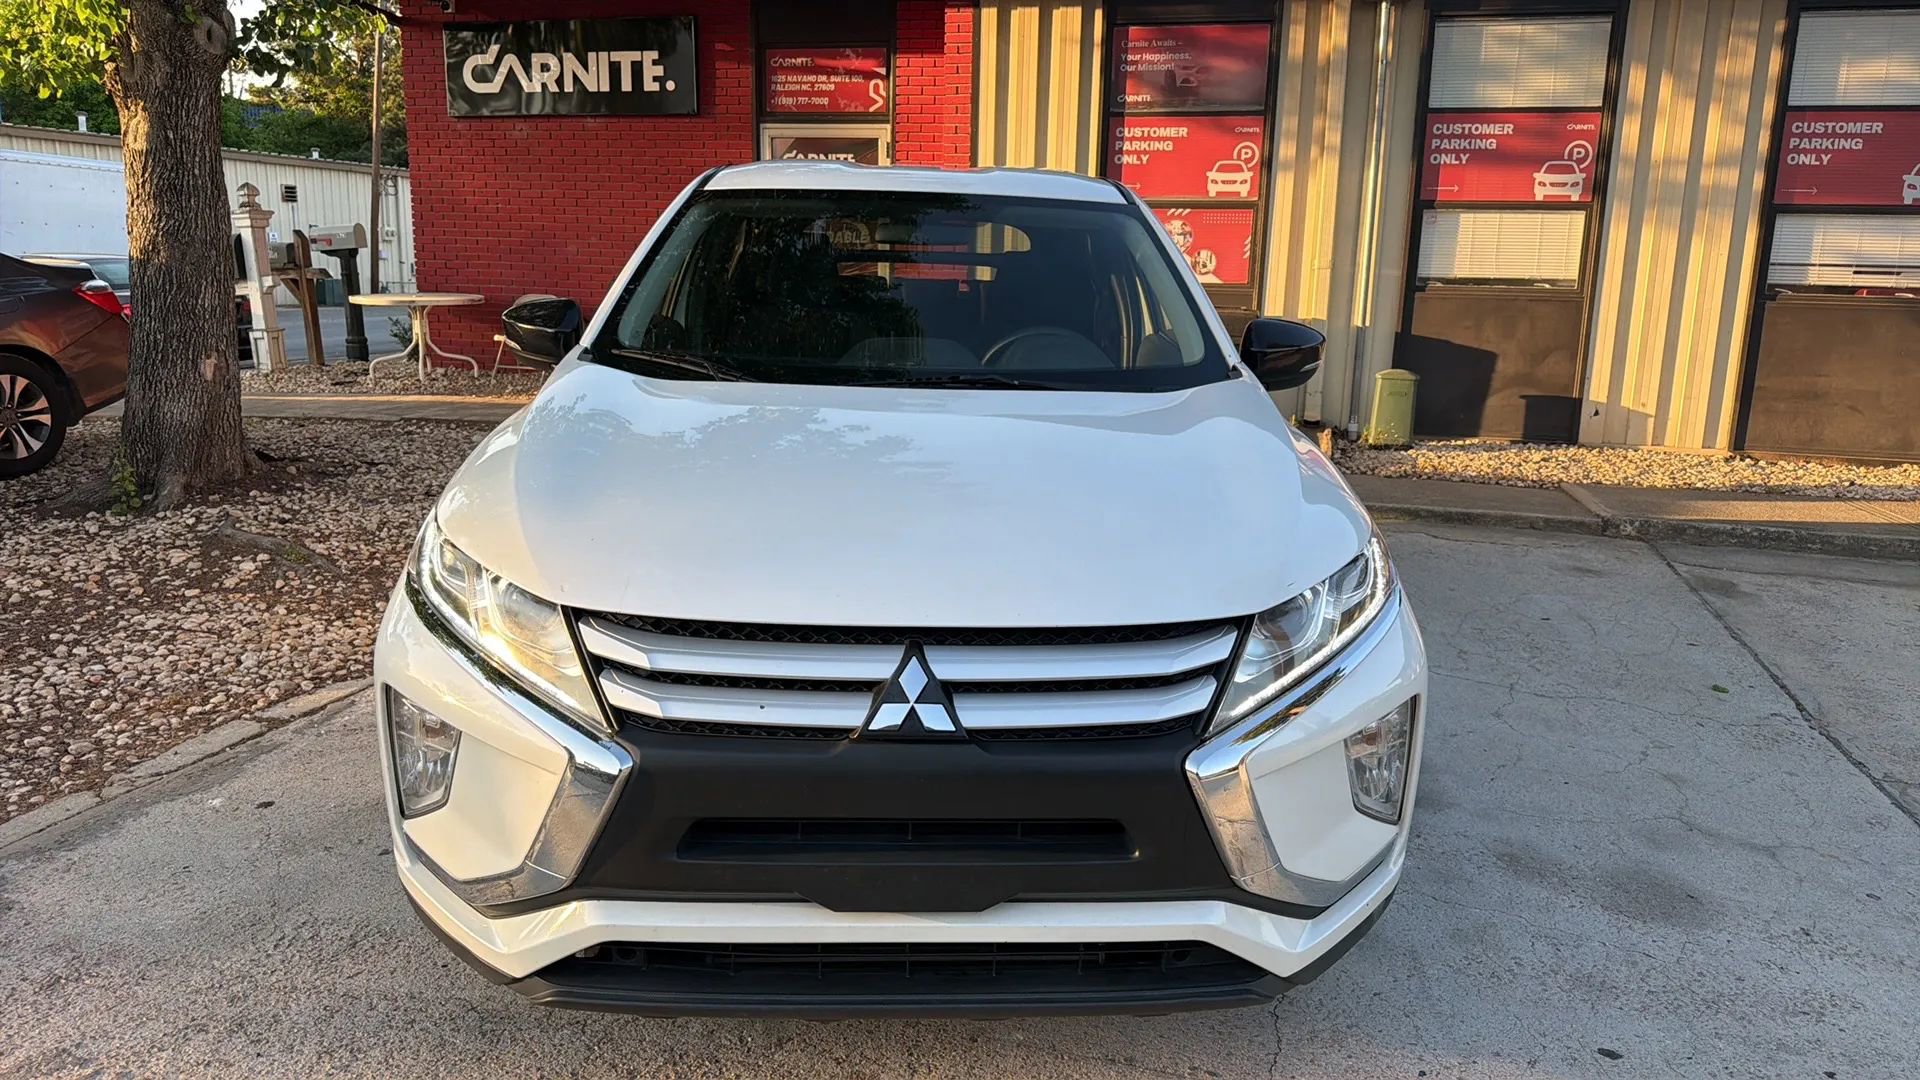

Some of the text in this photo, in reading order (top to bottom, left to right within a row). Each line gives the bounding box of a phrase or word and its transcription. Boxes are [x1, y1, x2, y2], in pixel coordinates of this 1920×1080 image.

[1121, 40, 1149, 48] Carnite
[1150, 39, 1177, 48] Awaits
[1120, 52, 1192, 62] Your Happiness,
[462, 44, 676, 94] CARNITE.
[1137, 62, 1175, 71] Mission!
[1116, 127, 1188, 137] CUSTOMER
[1432, 123, 1514, 135] CUSTOMER
[1791, 122, 1883, 134] CUSTOMER
[1115, 141, 1173, 151] PARKING
[1431, 138, 1497, 149] PARKING
[1789, 138, 1864, 149] PARKING
[1114, 154, 1150, 164] ONLY
[1430, 153, 1470, 164] ONLY
[1786, 153, 1832, 165] ONLY
